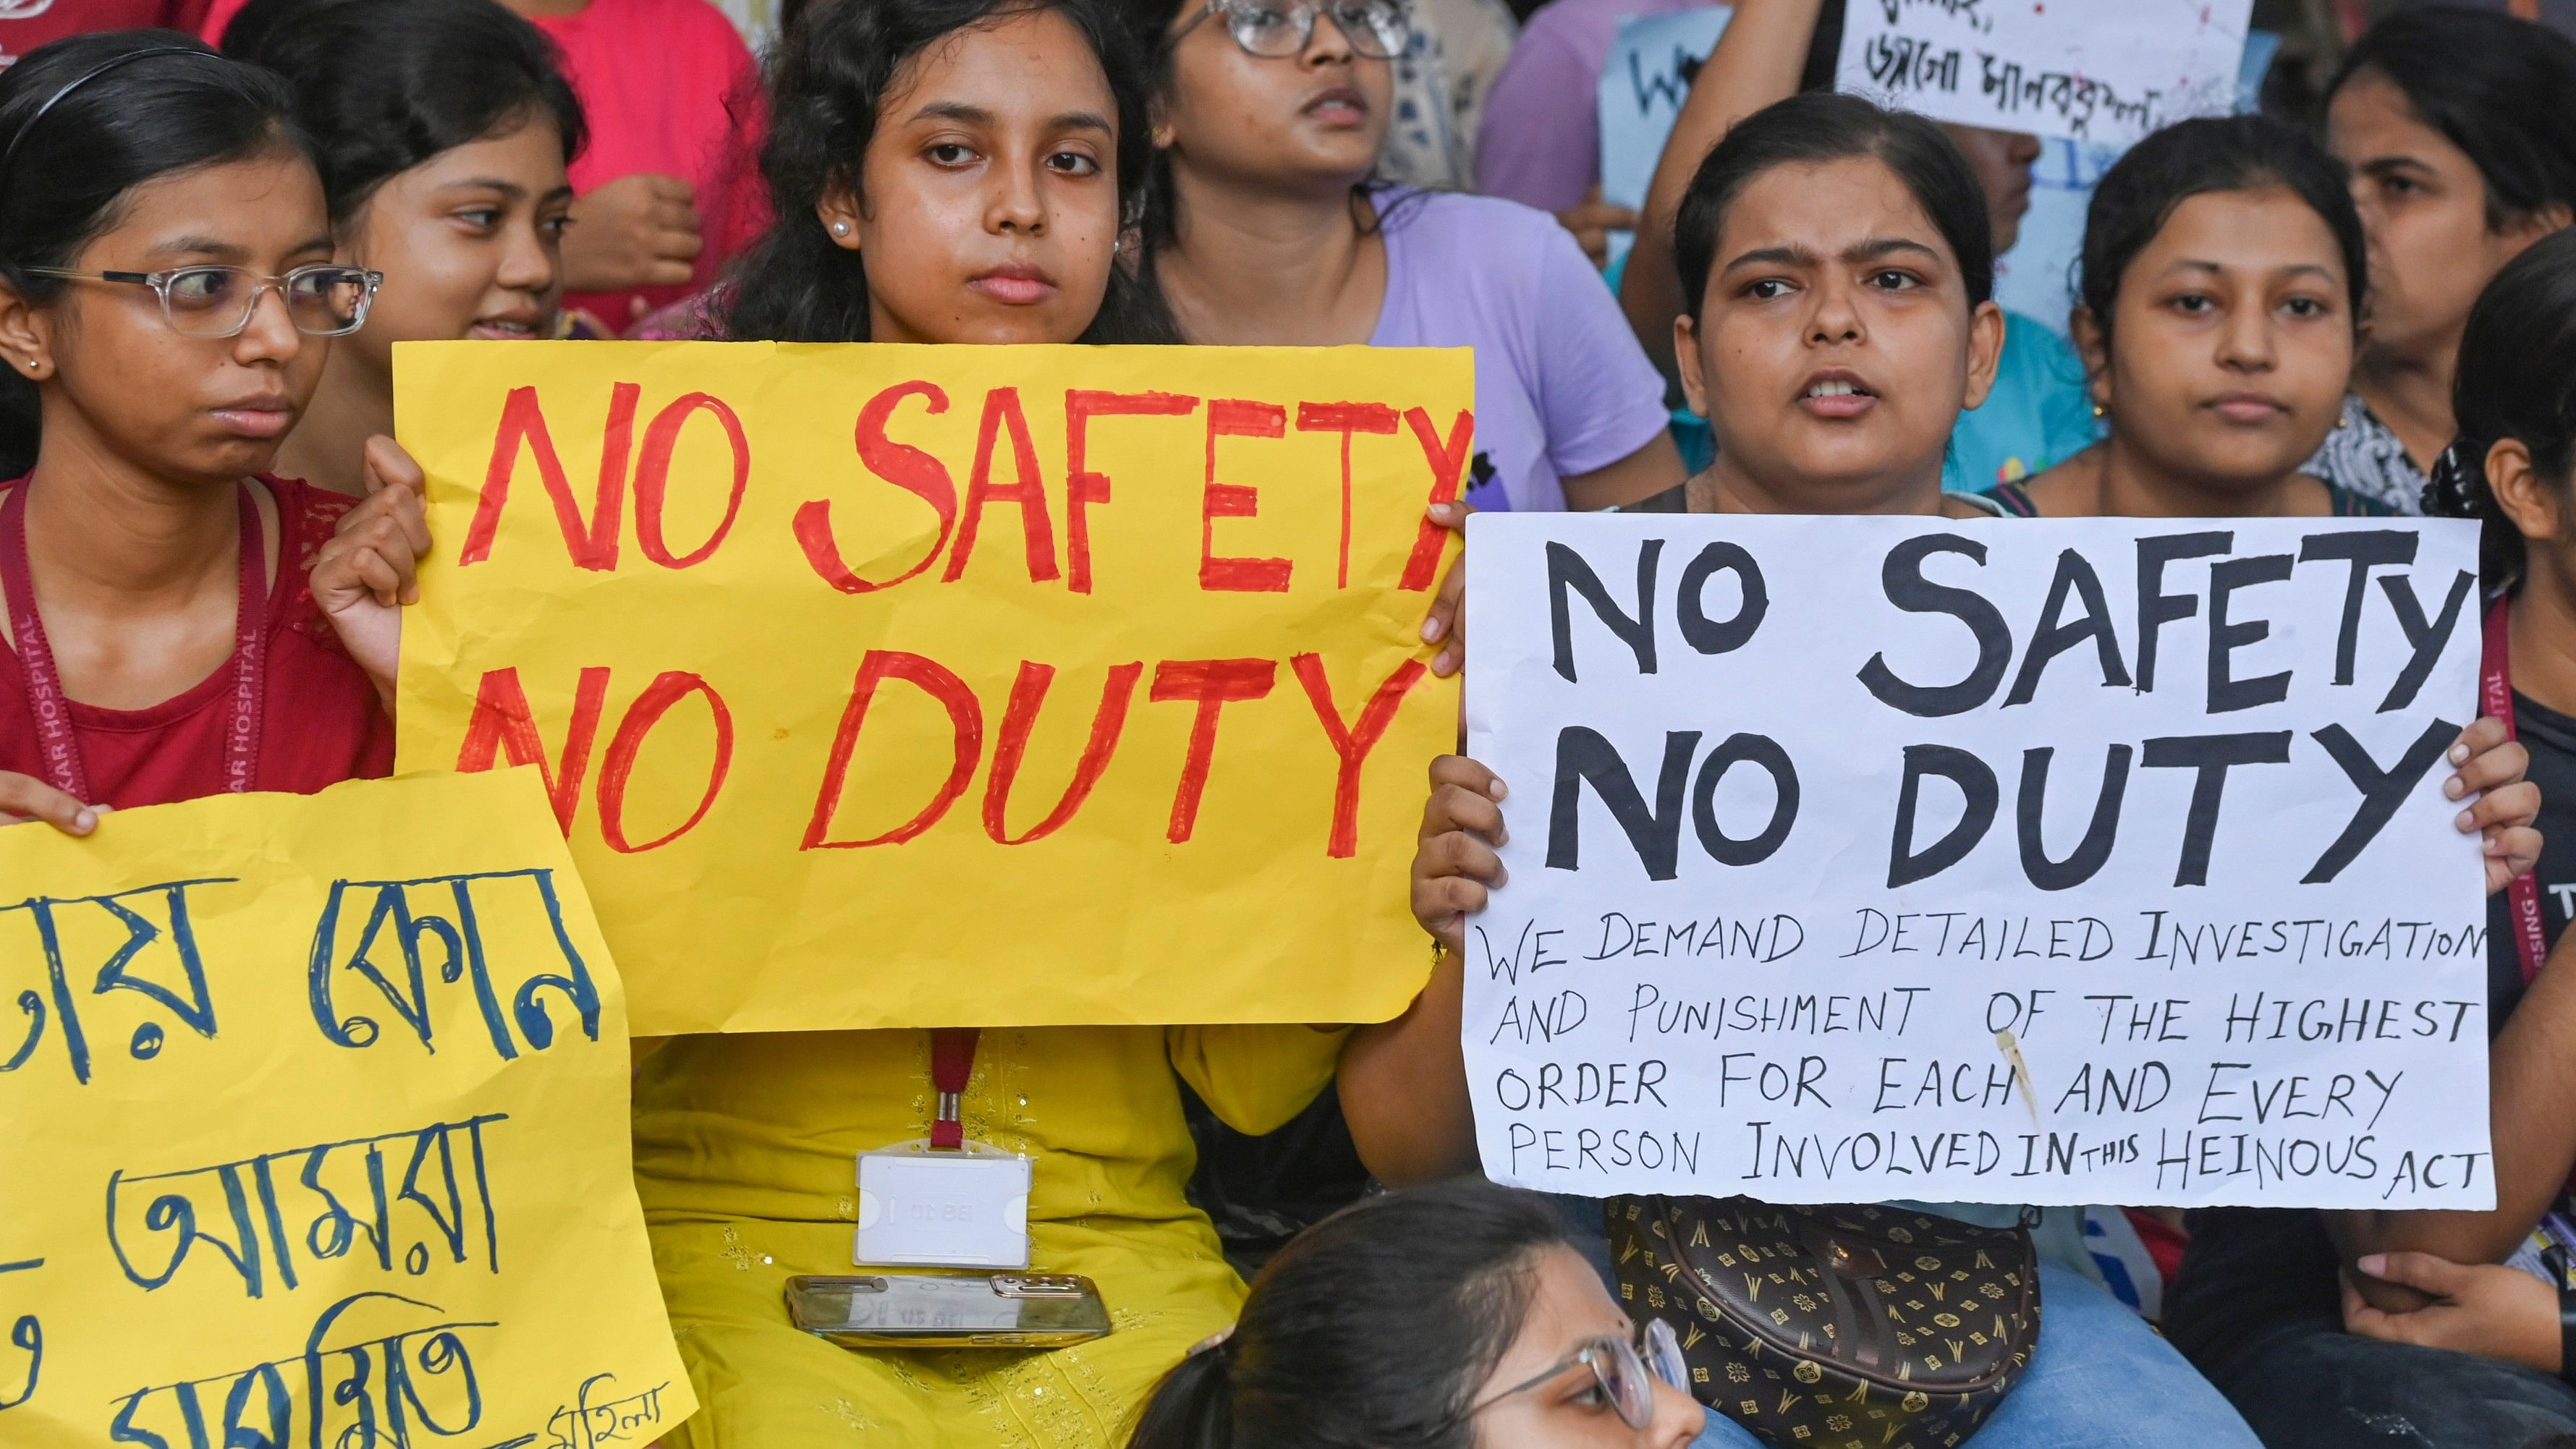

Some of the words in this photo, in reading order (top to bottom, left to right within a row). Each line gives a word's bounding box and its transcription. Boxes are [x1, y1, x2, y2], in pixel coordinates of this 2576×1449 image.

[461, 383, 750, 571] NO
[793, 381, 1474, 595] SAFETY
[20, 613, 64, 739] HOSPITAL
[1546, 539, 1770, 684] NO
[1857, 530, 2479, 716] SAFETY
[233, 629, 256, 753] HOSPITAL
[457, 668, 734, 854] NO
[800, 651, 1427, 859] DUTY
[1545, 726, 1800, 882] NO
[1887, 718, 2462, 891] DUTY
[1475, 918, 1567, 985] WE
[1583, 912, 1804, 963] DEMAND
[1839, 908, 2113, 962] DETAILED
[2135, 911, 2488, 971] INVESTIGATION
[1490, 990, 1587, 1045] AND
[1628, 983, 1931, 1043] PUNISHMENT
[1986, 990, 2056, 1039] OF
[2084, 995, 2190, 1045] THE
[2225, 992, 2480, 1042] HIGHEST
[1496, 1060, 1667, 1111] ORDER
[1721, 1053, 1832, 1108] FOR
[1873, 1058, 2017, 1113] EACH
[2054, 1061, 2171, 1116] AND
[2198, 1062, 2404, 1131] EVERY
[108, 1114, 509, 1299] আমরা
[1509, 1123, 1700, 1176] PERSON
[1741, 1121, 2000, 1180] INVOLVED
[2011, 1132, 2079, 1176] IN
[2080, 1134, 2139, 1172] THIS
[2156, 1128, 2378, 1190] HEINOUS
[2382, 1151, 2490, 1200] ACT
